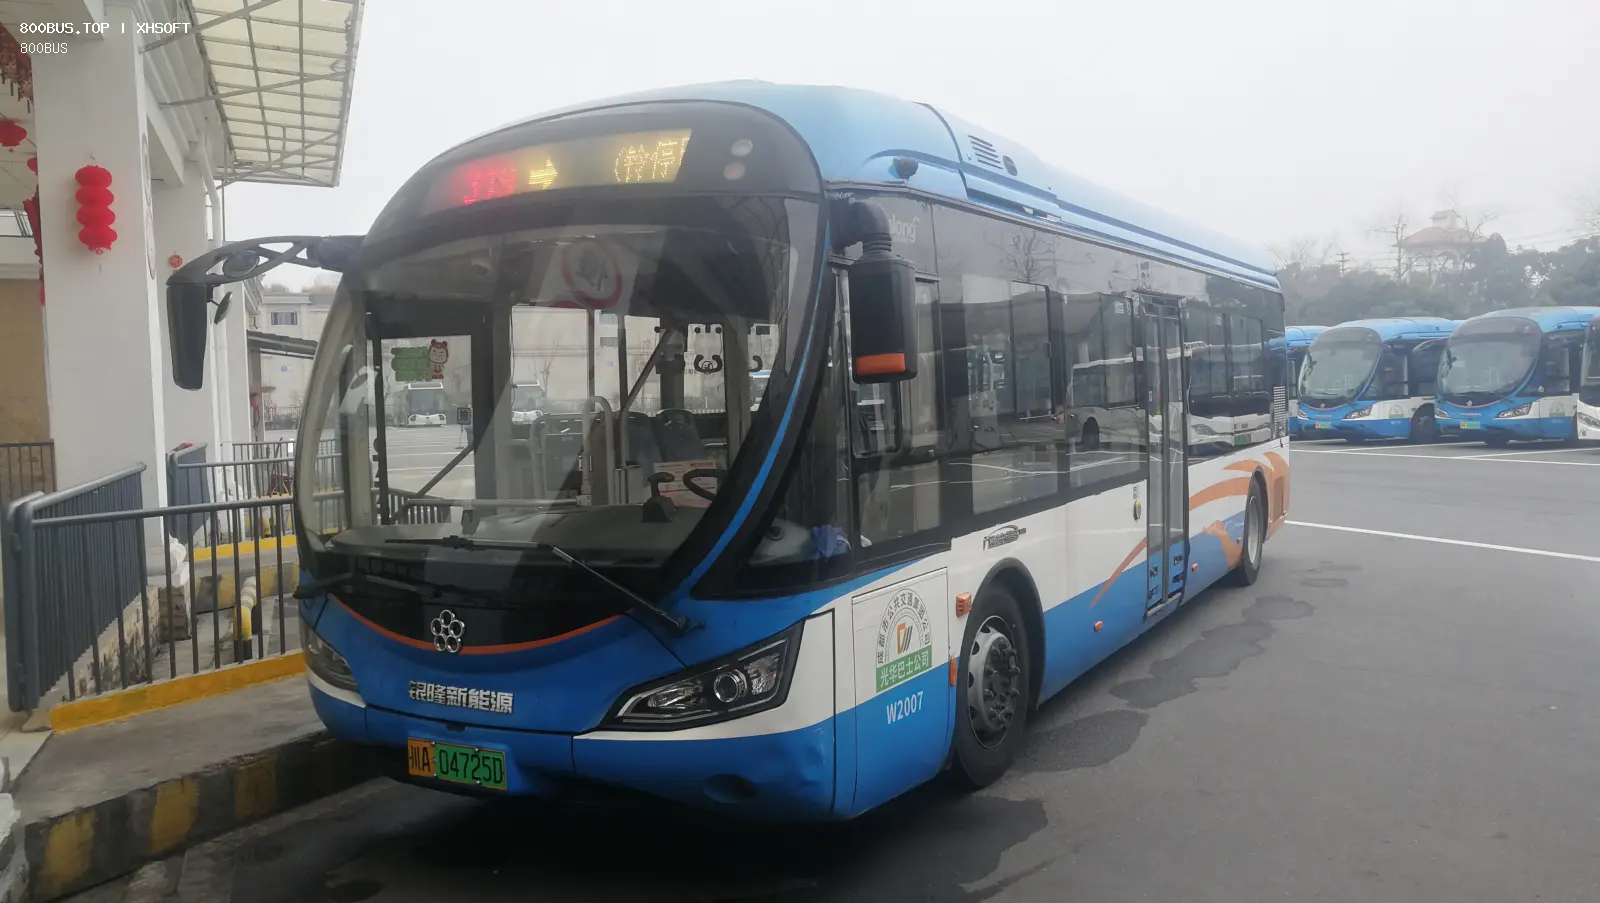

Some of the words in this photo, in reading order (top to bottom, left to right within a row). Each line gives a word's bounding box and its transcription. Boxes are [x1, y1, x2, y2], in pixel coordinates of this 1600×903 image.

[880, 650, 930, 688] 光华巴士公司
[408, 680, 514, 714] 银隆新能源
[886, 690, 924, 725] W2007
